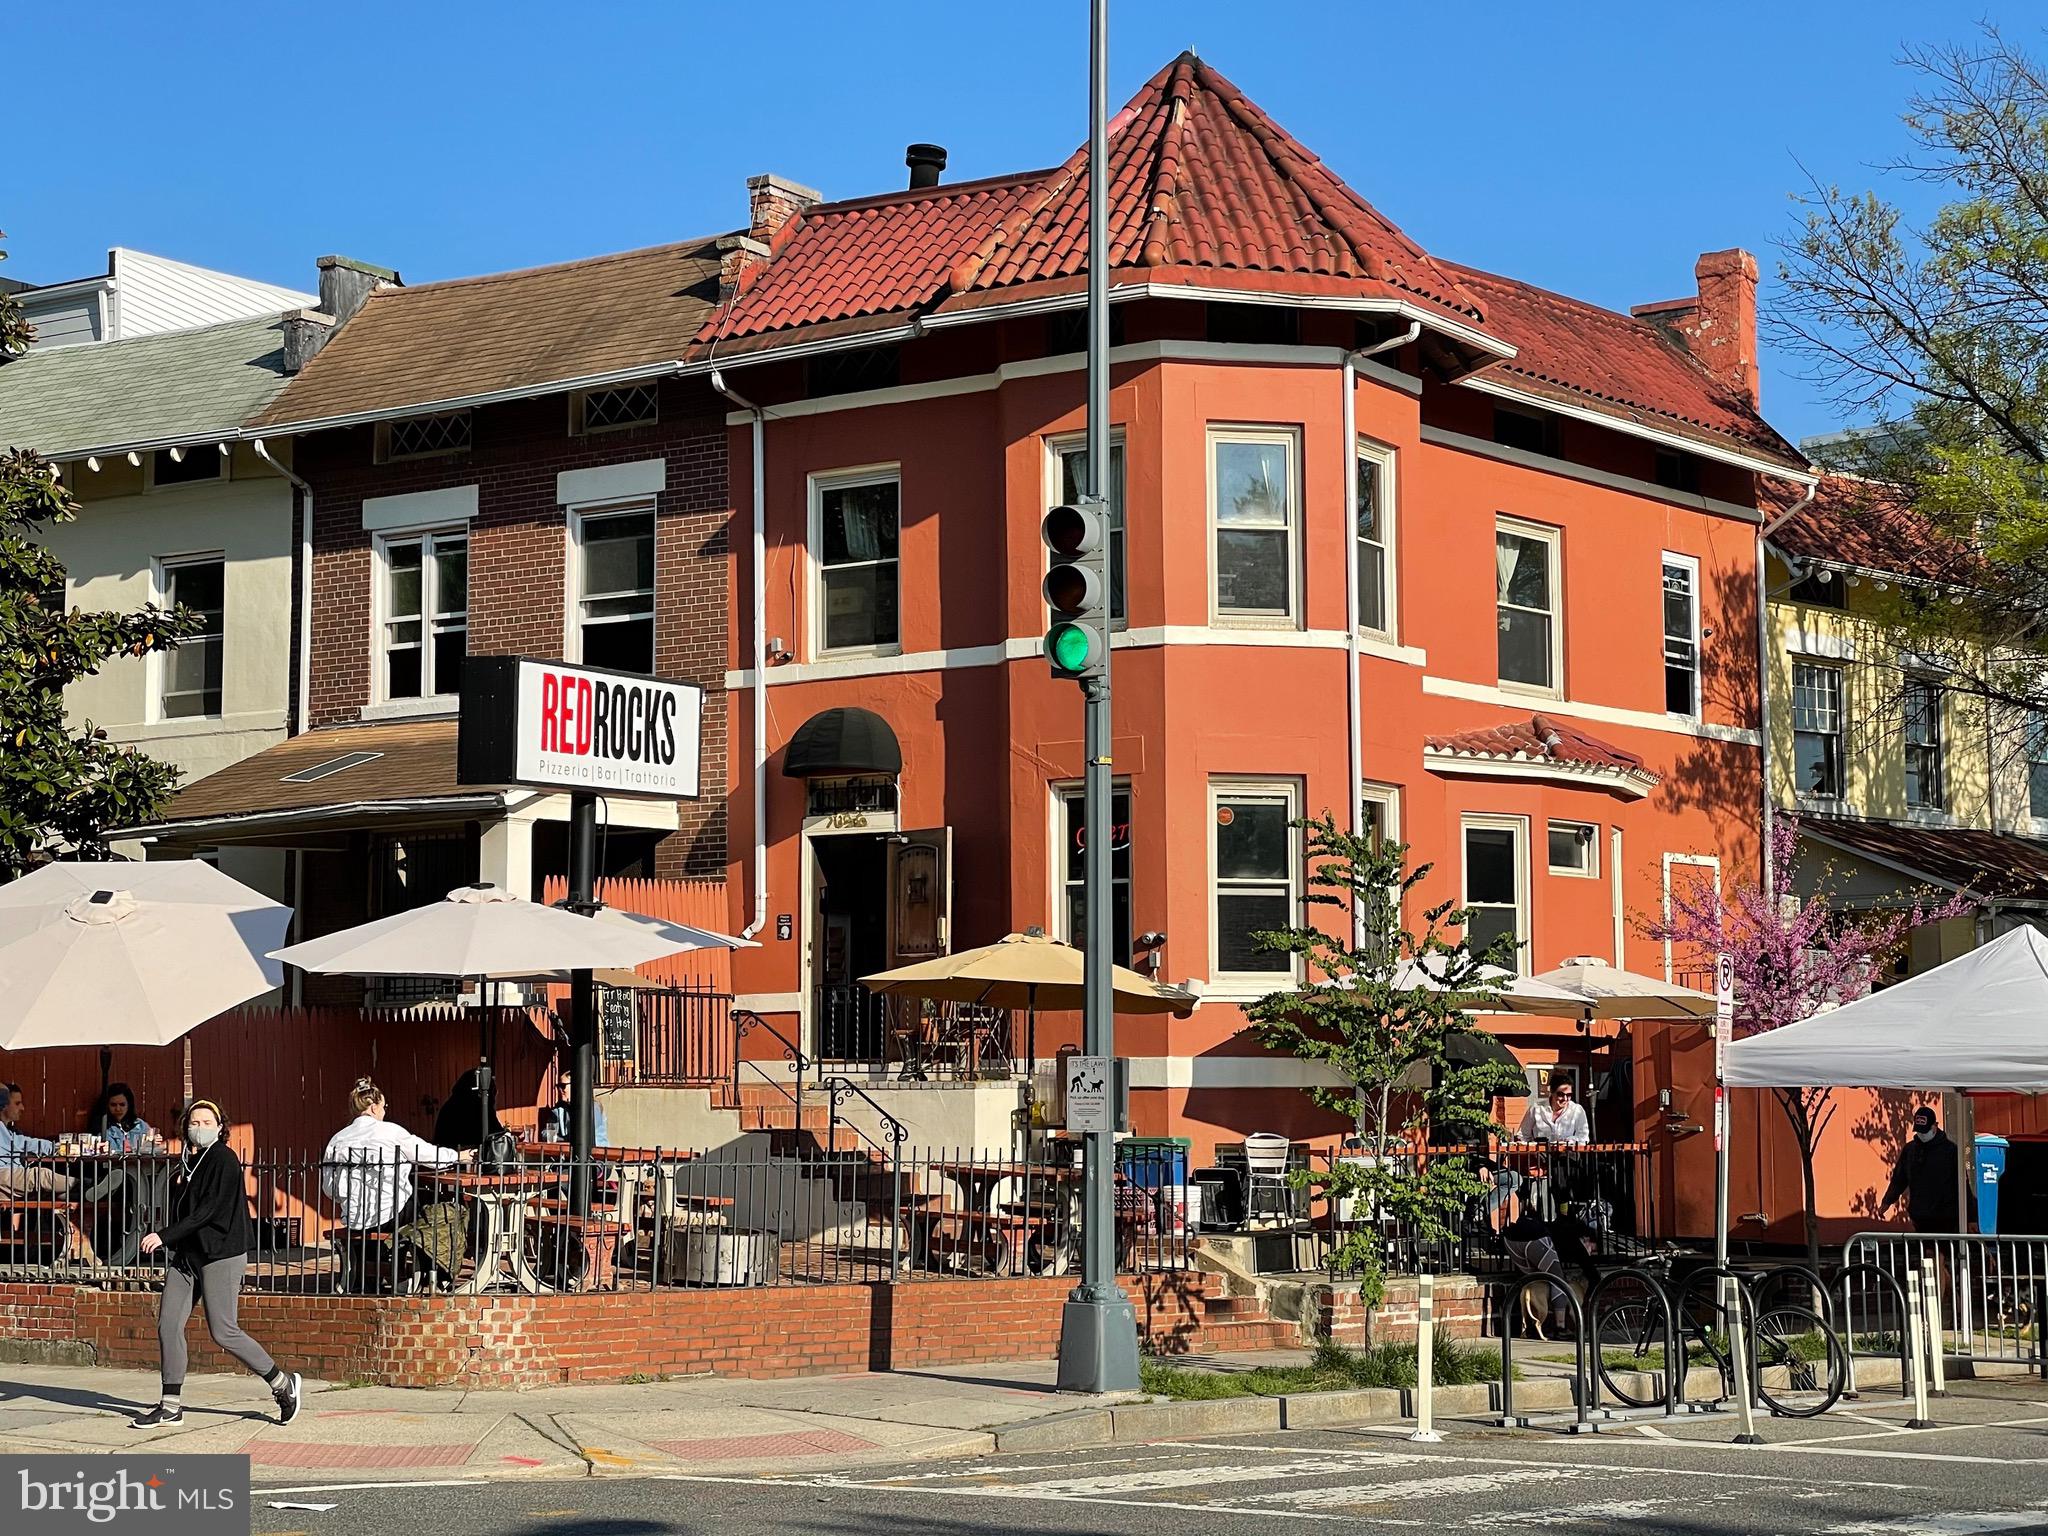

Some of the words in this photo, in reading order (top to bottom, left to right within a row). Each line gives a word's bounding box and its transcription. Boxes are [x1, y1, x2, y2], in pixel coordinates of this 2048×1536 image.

[541, 672, 676, 765] REDROCKS
[539, 760, 588, 778] Pizzeria
[597, 766, 617, 780] Bar
[625, 769, 676, 787] Trattoria
